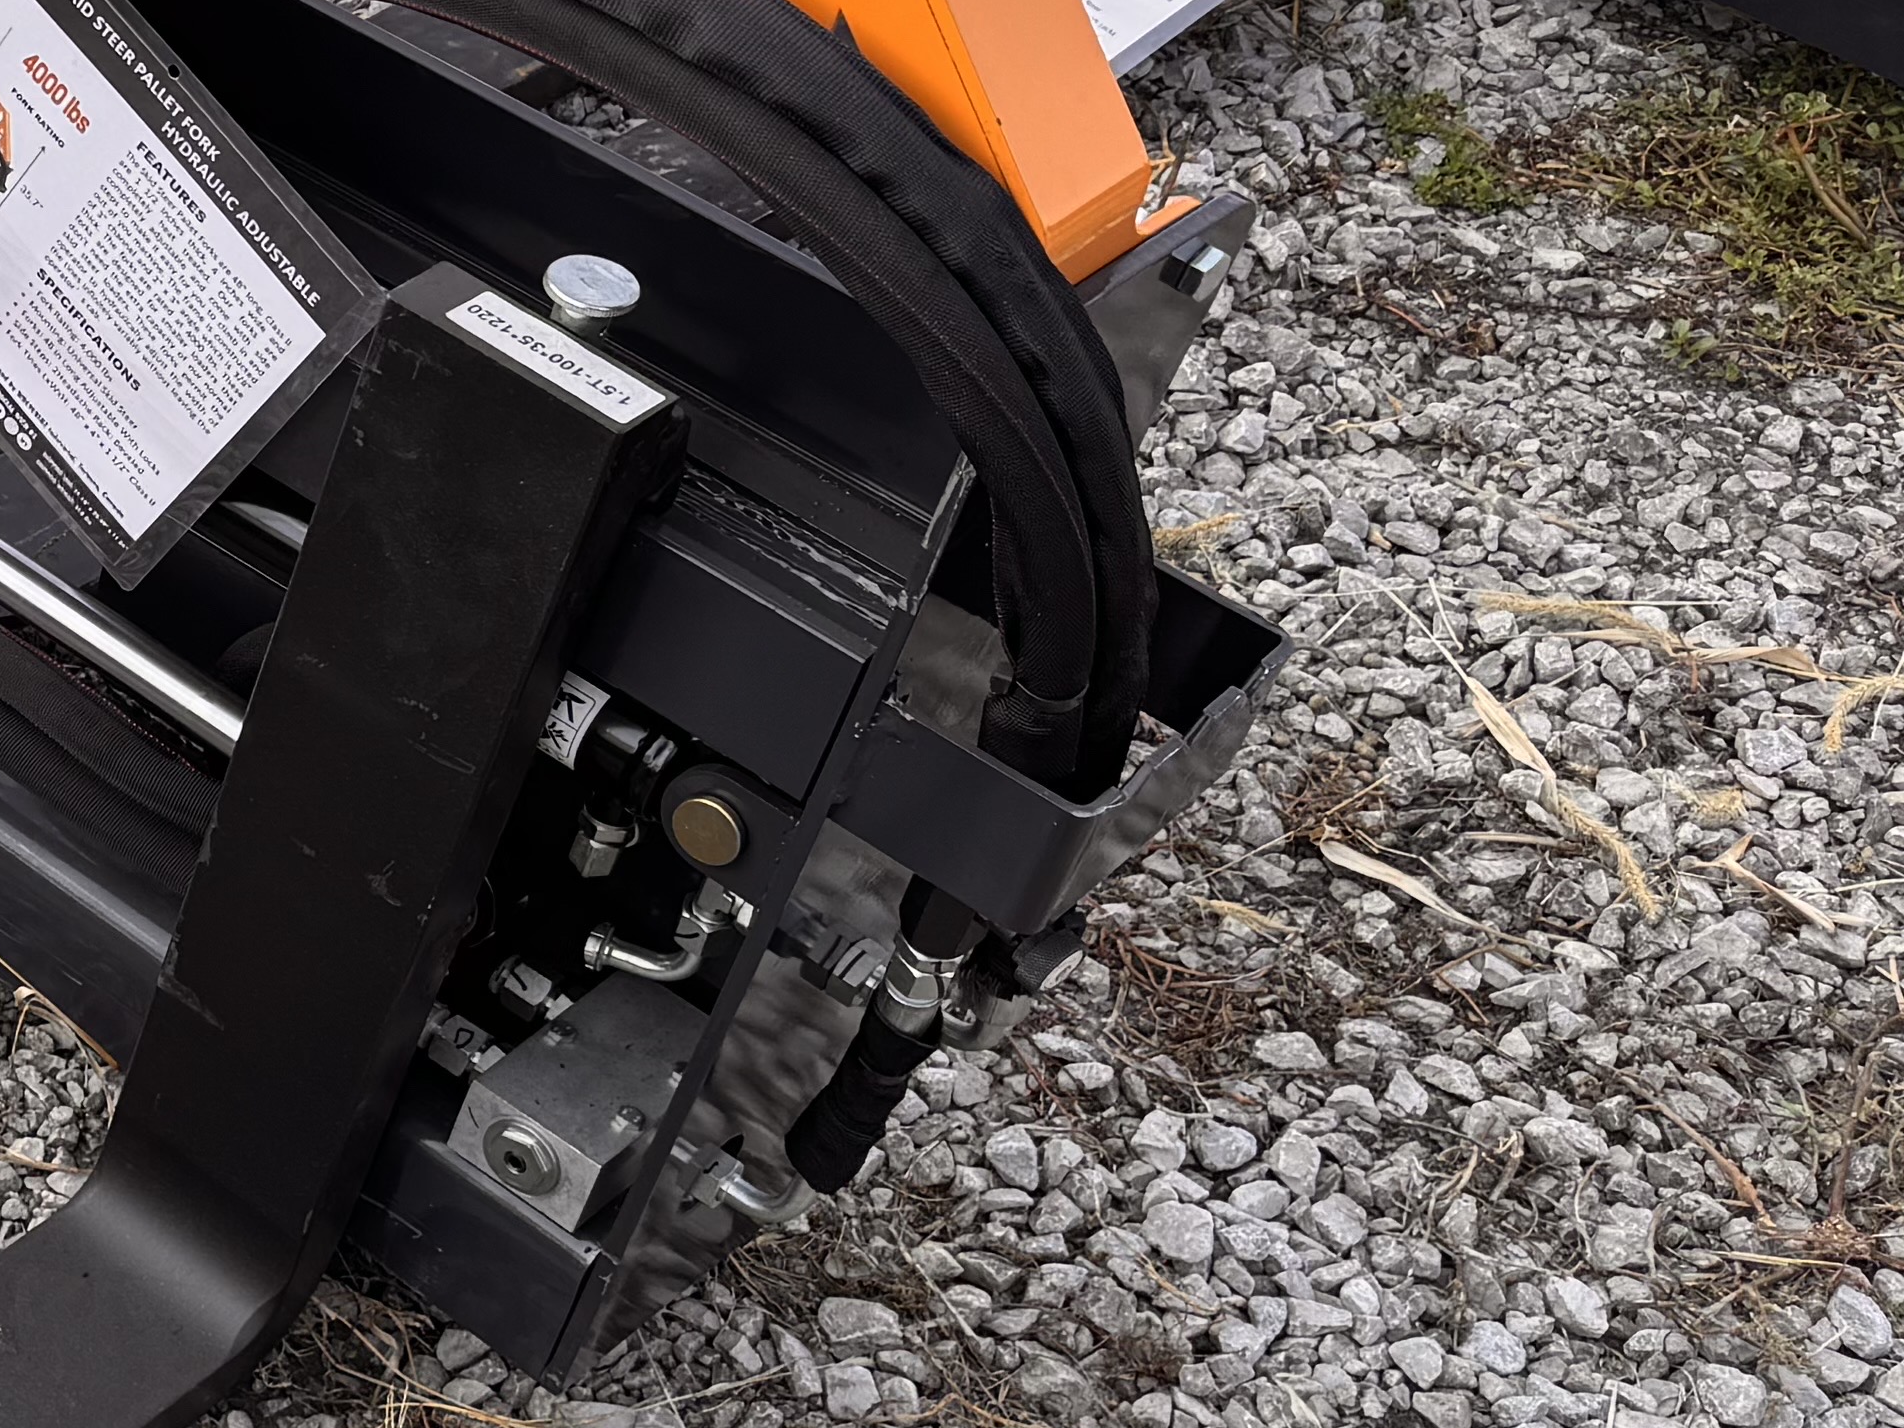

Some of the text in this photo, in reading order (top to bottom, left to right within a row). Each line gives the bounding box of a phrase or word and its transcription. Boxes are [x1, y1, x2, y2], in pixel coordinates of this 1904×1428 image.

[10, 86, 65, 148] FORK RATING
[21, 54, 90, 134] 4000 lbs
[92, 15, 135, 66] STEER
[133, 61, 184, 117] PALLET
[180, 115, 221, 162] FORK
[135, 140, 206, 223] FEATURES
[160, 120, 321, 307] HYDRAULIC ADJUSTABLE
[92, 191, 107, 208] out
[116, 219, 132, 237] you
[181, 295, 205, 322] frame
[119, 206, 130, 218] to
[129, 219, 151, 244] make
[206, 308, 216, 320] to
[248, 359, 265, 377] and
[136, 257, 153, 275] and
[143, 187, 158, 205] 1/2
[210, 267, 218, 275] 4
[268, 336, 286, 354] and
[158, 219, 176, 242] heat
[217, 289, 233, 308] Our
[263, 346, 278, 361] are
[189, 275, 206, 292] and
[233, 324, 251, 346] with
[36, 267, 141, 391] SPECIFICATIONS
